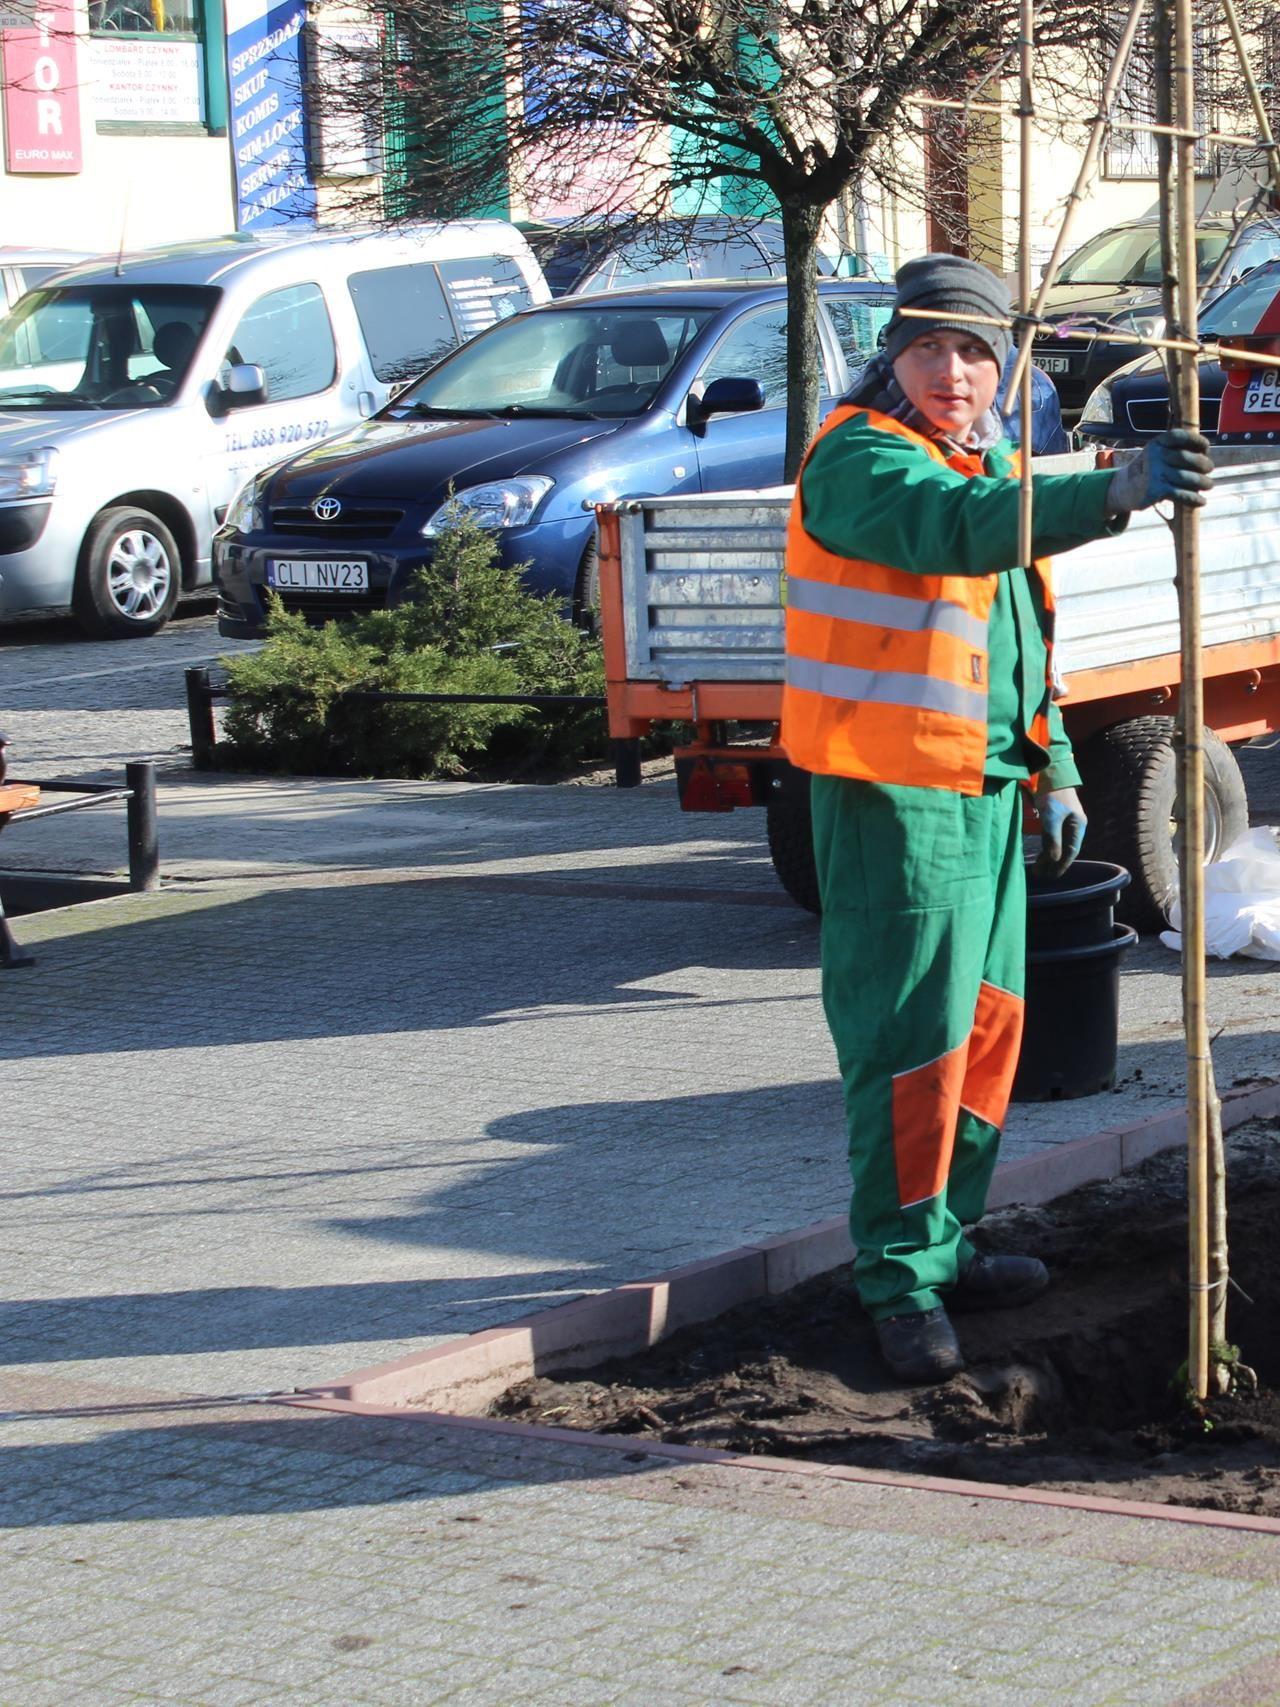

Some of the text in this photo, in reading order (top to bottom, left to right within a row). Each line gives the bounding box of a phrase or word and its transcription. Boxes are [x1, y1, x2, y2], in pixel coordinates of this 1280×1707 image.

[109, 83, 144, 91] KANTOR
[234, 68, 269, 107] SKUP
[236, 93, 279, 138] KOMIS
[15, 149, 74, 160] EURO MAX
[238, 109, 302, 168] SIM-LOCK
[241, 149, 291, 198] SERWIS
[241, 174, 306, 225] ZAMIANA
[252, 429, 276, 449] 888
[280, 424, 303, 444] 920
[305, 419, 329, 441] 572
[278, 563, 308, 585] CLI
[317, 563, 364, 586] NV23
